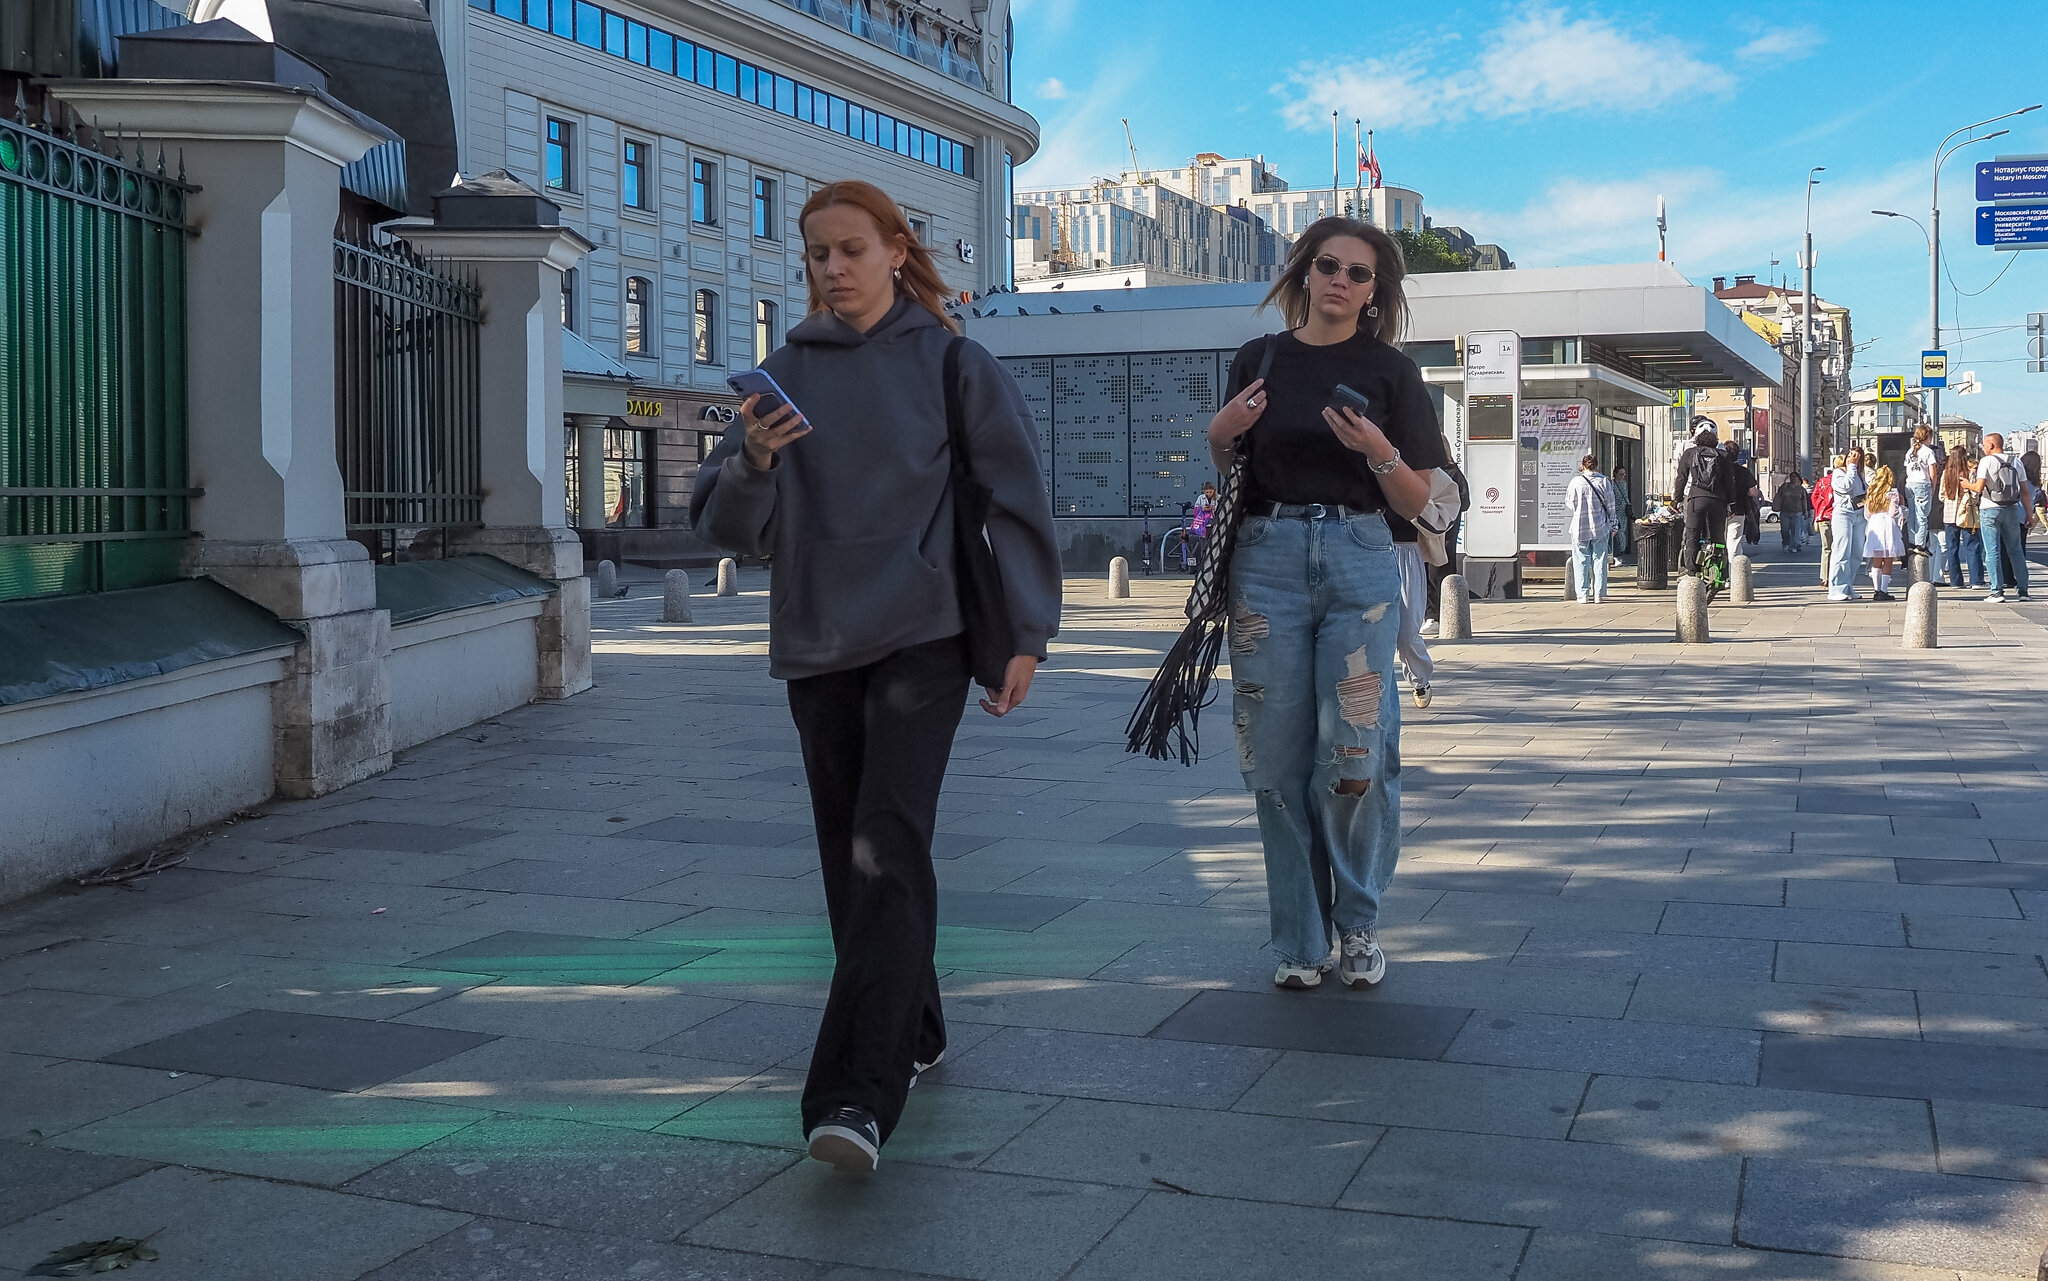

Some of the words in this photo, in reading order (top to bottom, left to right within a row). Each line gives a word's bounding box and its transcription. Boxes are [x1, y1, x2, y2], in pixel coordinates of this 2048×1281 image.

[1994, 166, 2027, 174] Нотариус
[1548, 416, 1556, 424] 18
[1557, 412, 1566, 420] 19
[1567, 409, 1578, 417] 20
[1540, 440, 1553, 455] 4
